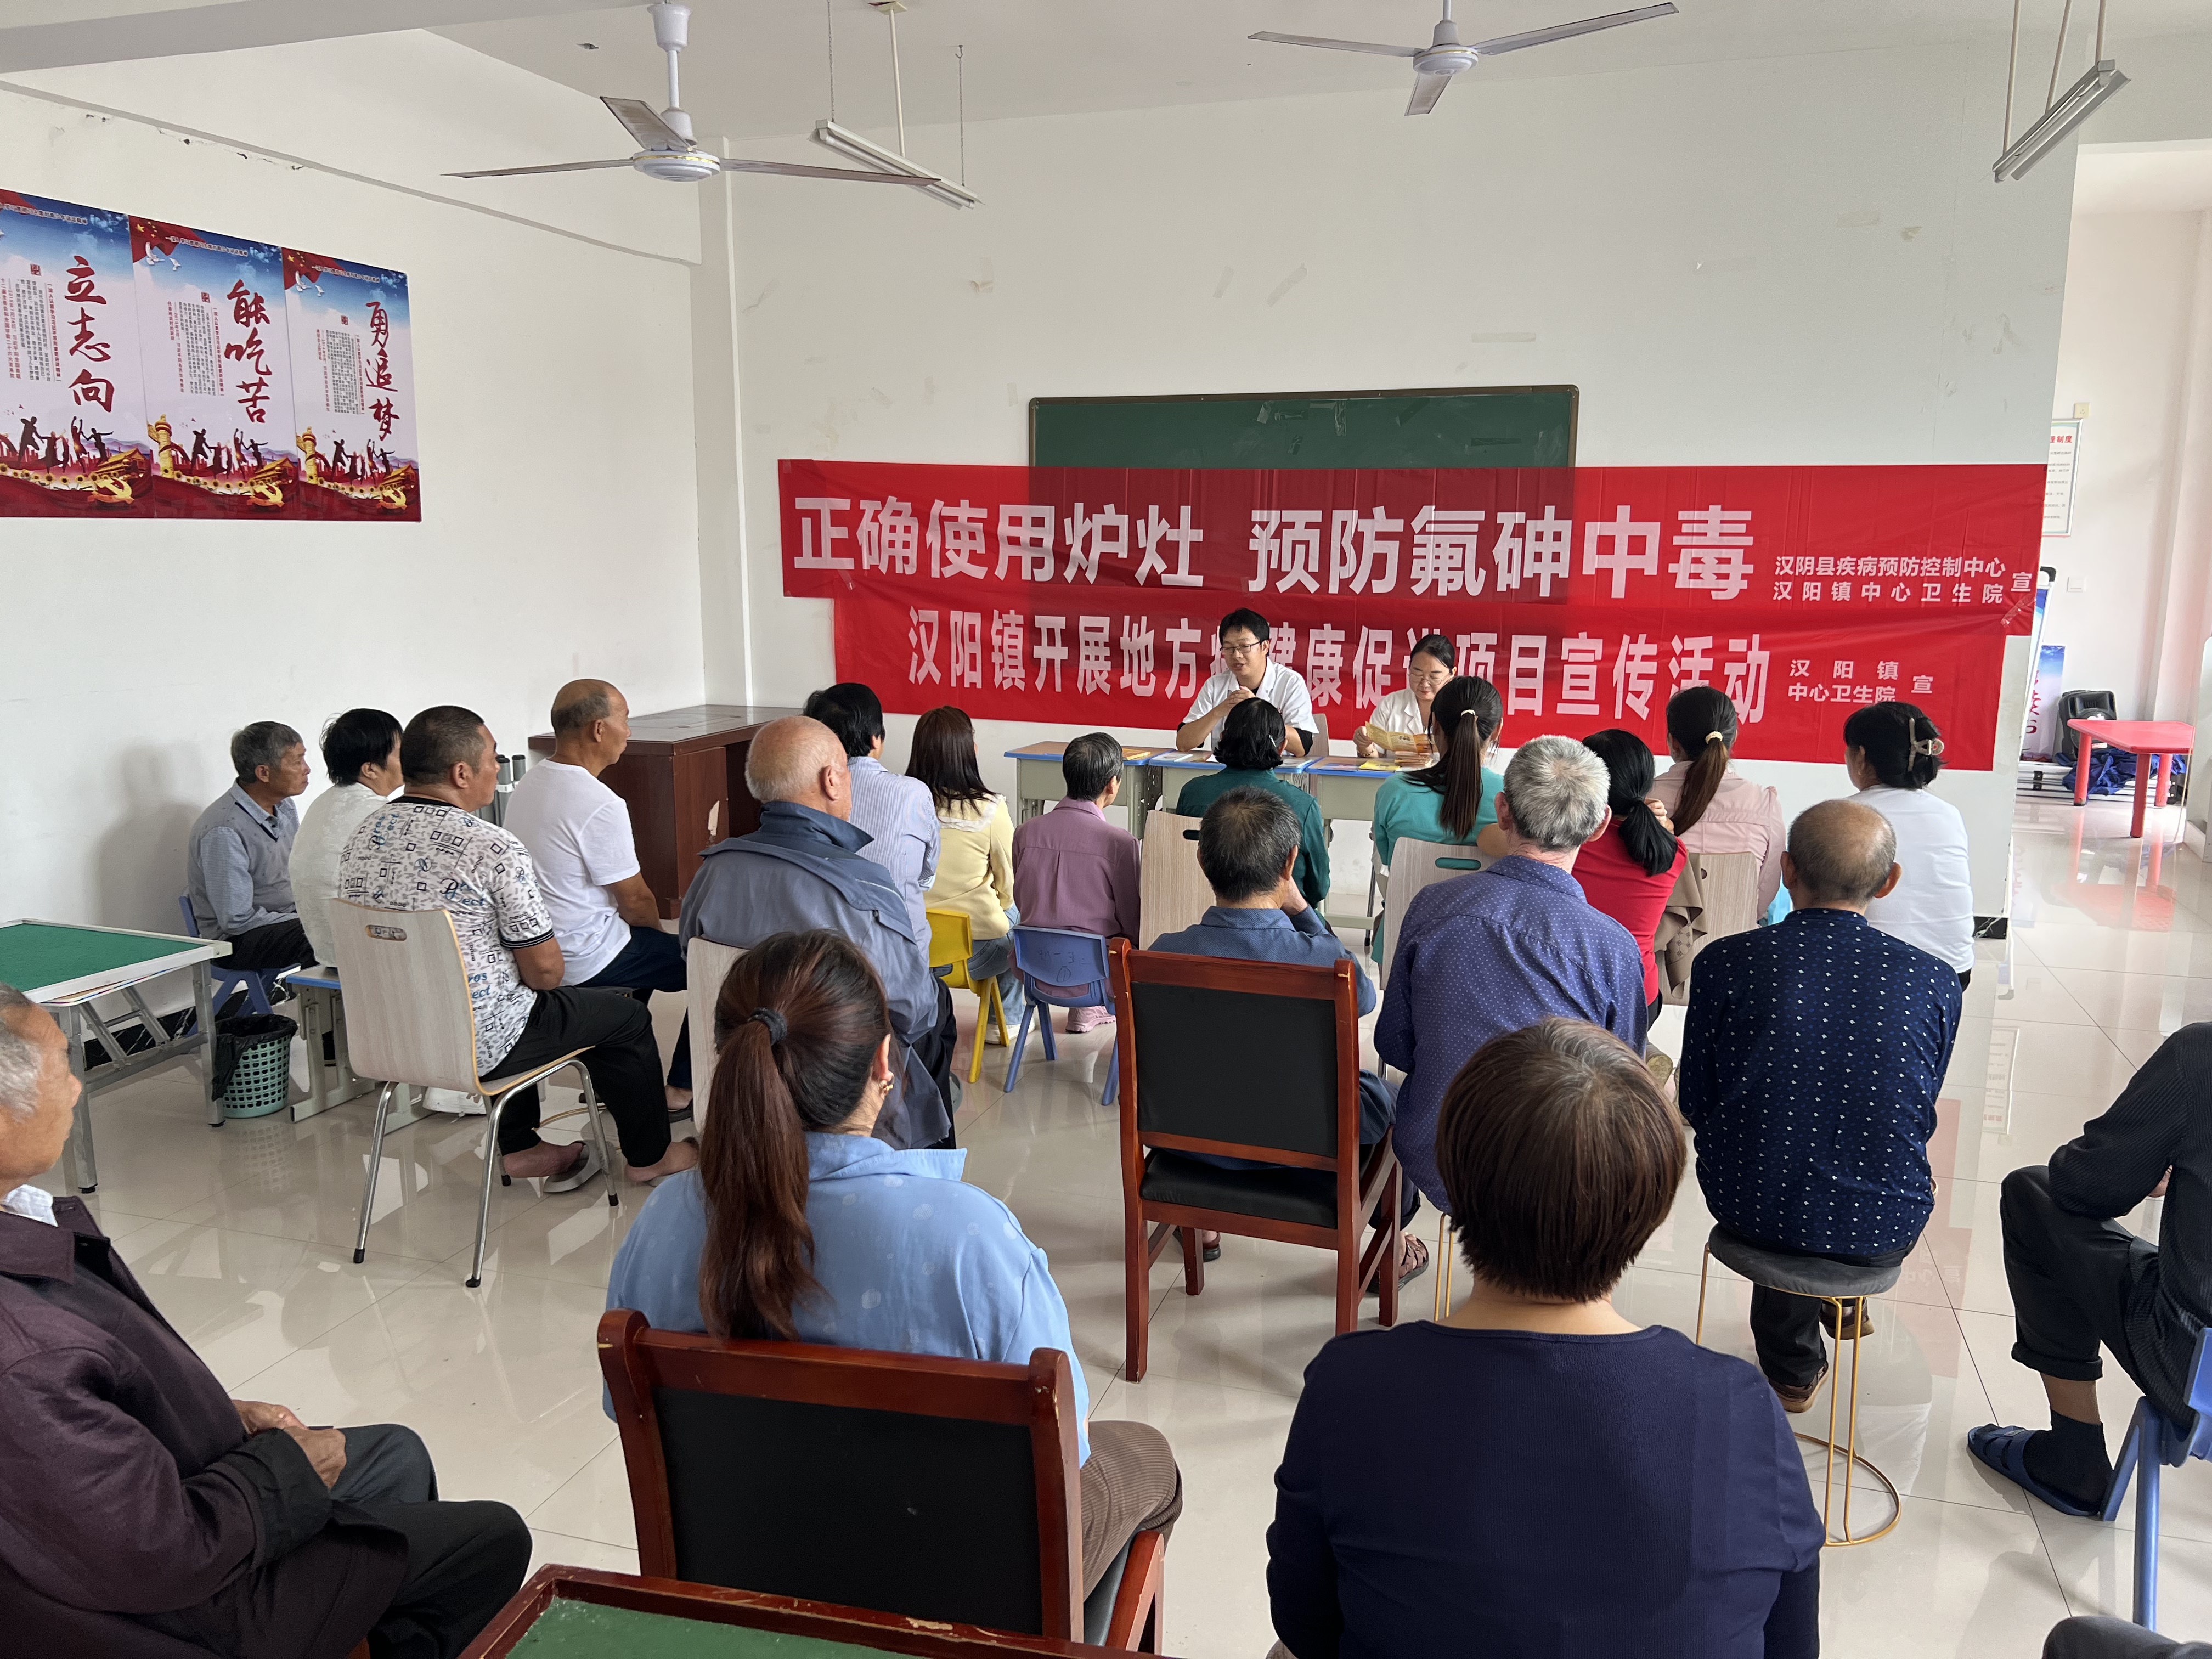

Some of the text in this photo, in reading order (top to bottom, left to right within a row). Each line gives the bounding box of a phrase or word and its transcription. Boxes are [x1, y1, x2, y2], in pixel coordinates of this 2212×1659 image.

[64, 255, 115, 413] 立志向
[223, 279, 273, 423] 能吃苦
[794, 496, 1754, 601] 正确使用炉灶 预防氟砷中毒
[1774, 556, 2006, 578] 汉阴县疾病预防控制中心
[1773, 582, 2004, 603] 汉阳镇中心卫生院
[2010, 572, 2033, 592] 宣
[908, 606, 1770, 725] 汉阳镇开展地方健康促项目宣传活动
[1789, 659, 1899, 680] 汉阳镇
[1788, 682, 1896, 704] 中心卫生院
[1911, 675, 1934, 693] 宣
